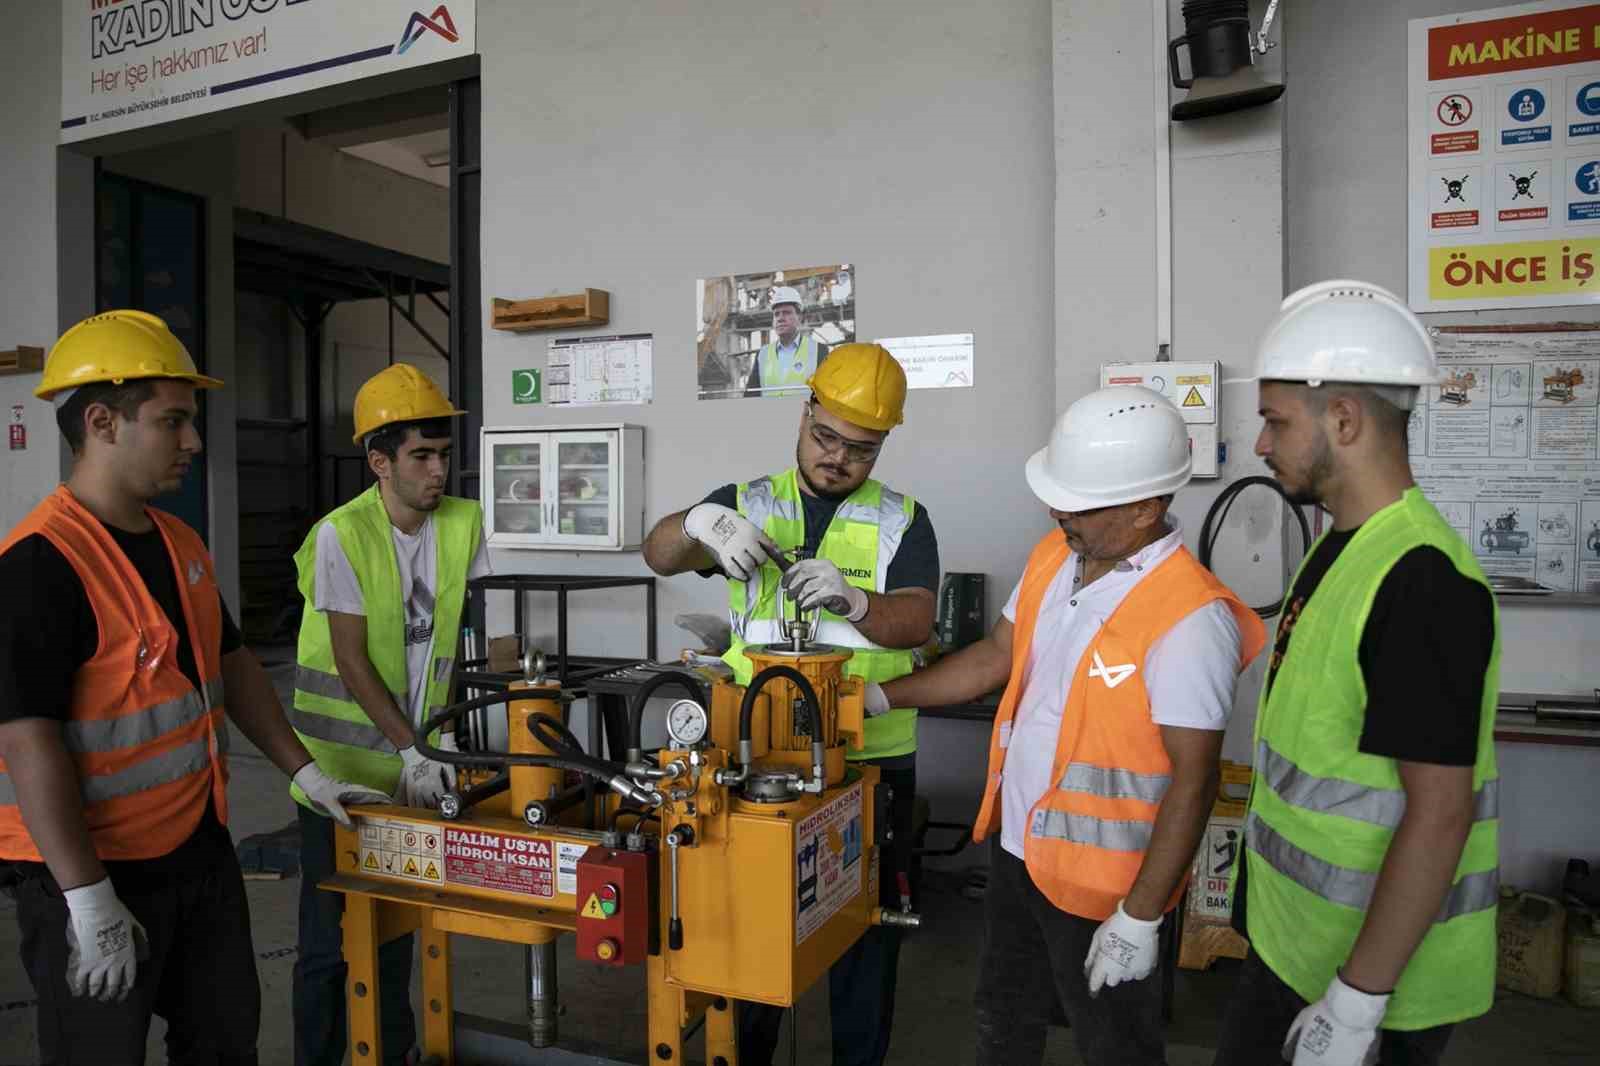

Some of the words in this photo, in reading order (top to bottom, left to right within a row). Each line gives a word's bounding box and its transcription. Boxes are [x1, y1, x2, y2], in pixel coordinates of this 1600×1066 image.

[91, 0, 214, 58] KADIN
[1447, 27, 1581, 67] MAKİNE
[91, 69, 121, 94] Her
[125, 62, 148, 92] işe
[152, 42, 229, 80] hakkımız
[232, 25, 267, 60] var!
[1443, 252, 1546, 287] ÖNCE
[1561, 246, 1595, 287] İŞ
[445, 829, 499, 849] HALİM
[504, 838, 549, 855] USTA
[446, 842, 551, 868] HİDROLİKSAN
